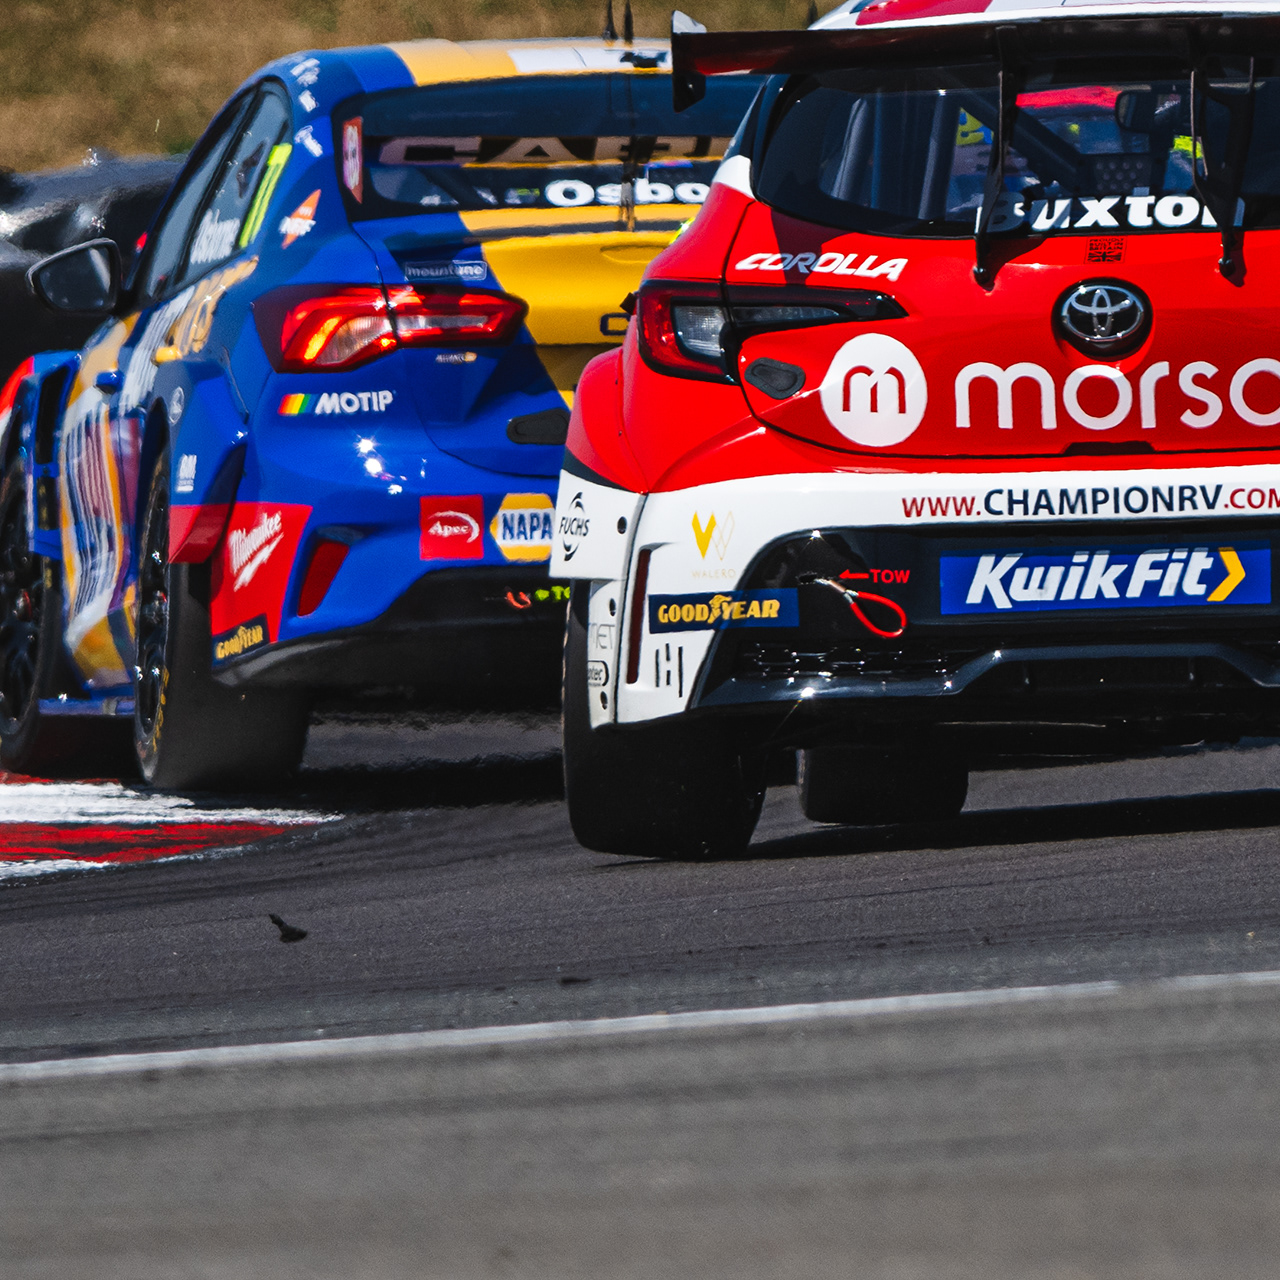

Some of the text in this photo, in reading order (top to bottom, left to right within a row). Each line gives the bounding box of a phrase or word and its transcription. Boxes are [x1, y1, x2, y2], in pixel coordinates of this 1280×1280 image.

[544, 176, 712, 207] Osbo
[735, 251, 909, 282] COROLLA
[315, 390, 393, 415] MOTIP
[427, 521, 469, 542] Apec
[502, 513, 553, 542] NAPA
[558, 516, 591, 538] FUCHS
[691, 568, 737, 580] WALERO
[868, 568, 911, 585] TOW
[658, 595, 780, 624] GOODYEAR
